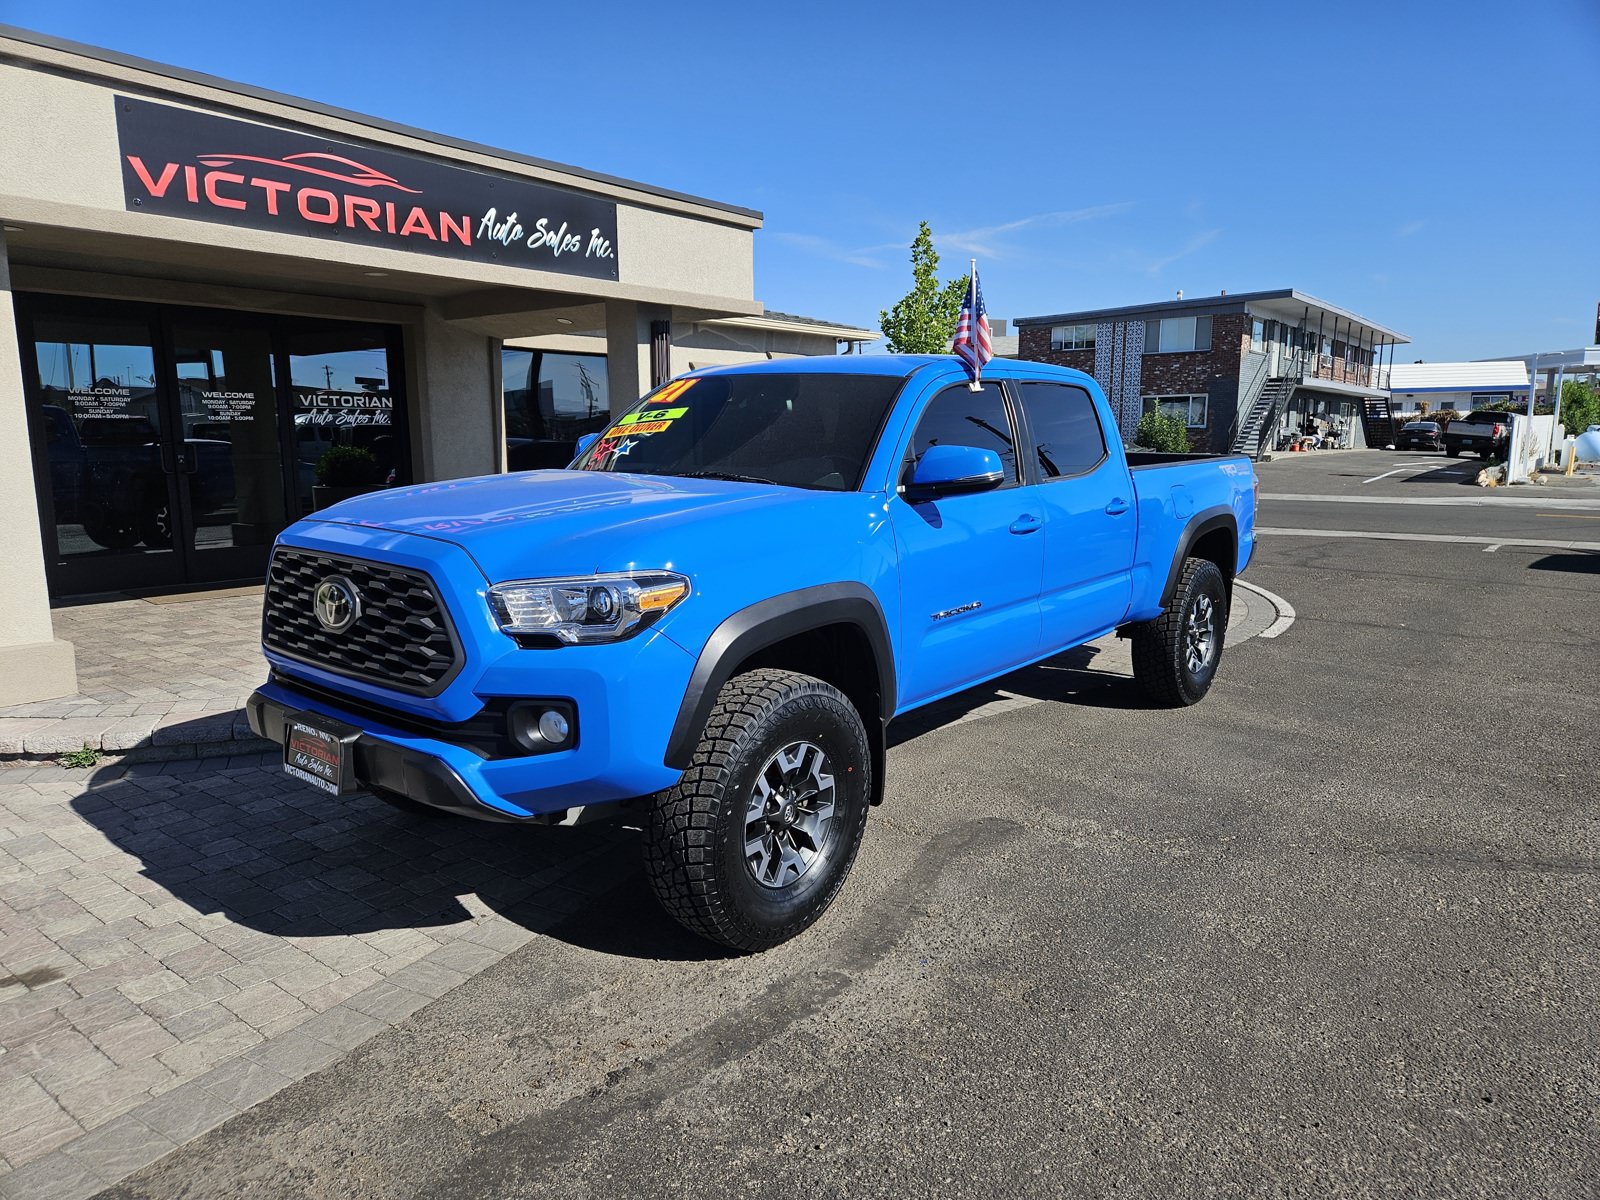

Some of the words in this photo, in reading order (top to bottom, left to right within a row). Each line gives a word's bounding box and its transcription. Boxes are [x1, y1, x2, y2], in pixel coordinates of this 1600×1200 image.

[126, 155, 472, 247] VICTORIAN
[476, 207, 524, 247] Auto
[526, 217, 581, 258] Sales
[585, 227, 615, 259] Inc.
[68, 387, 130, 395] WELCOME
[201, 391, 255, 399] WELCOME
[299, 394, 393, 408] VICTORIAN
[305, 408, 333, 426] Auto
[335, 409, 369, 427] Sales
[372, 409, 391, 425] Inc.
[637, 410, 668, 420] V-6
[609, 425, 629, 437] ONE
[629, 421, 666, 434] OWNER
[297, 723, 318, 736] RENO,
[290, 739, 339, 766] VICTORIAN
[295, 753, 307, 766] Auto
[308, 759, 323, 772] Sales
[284, 762, 339, 797] VICTORIANAUTO.COM
